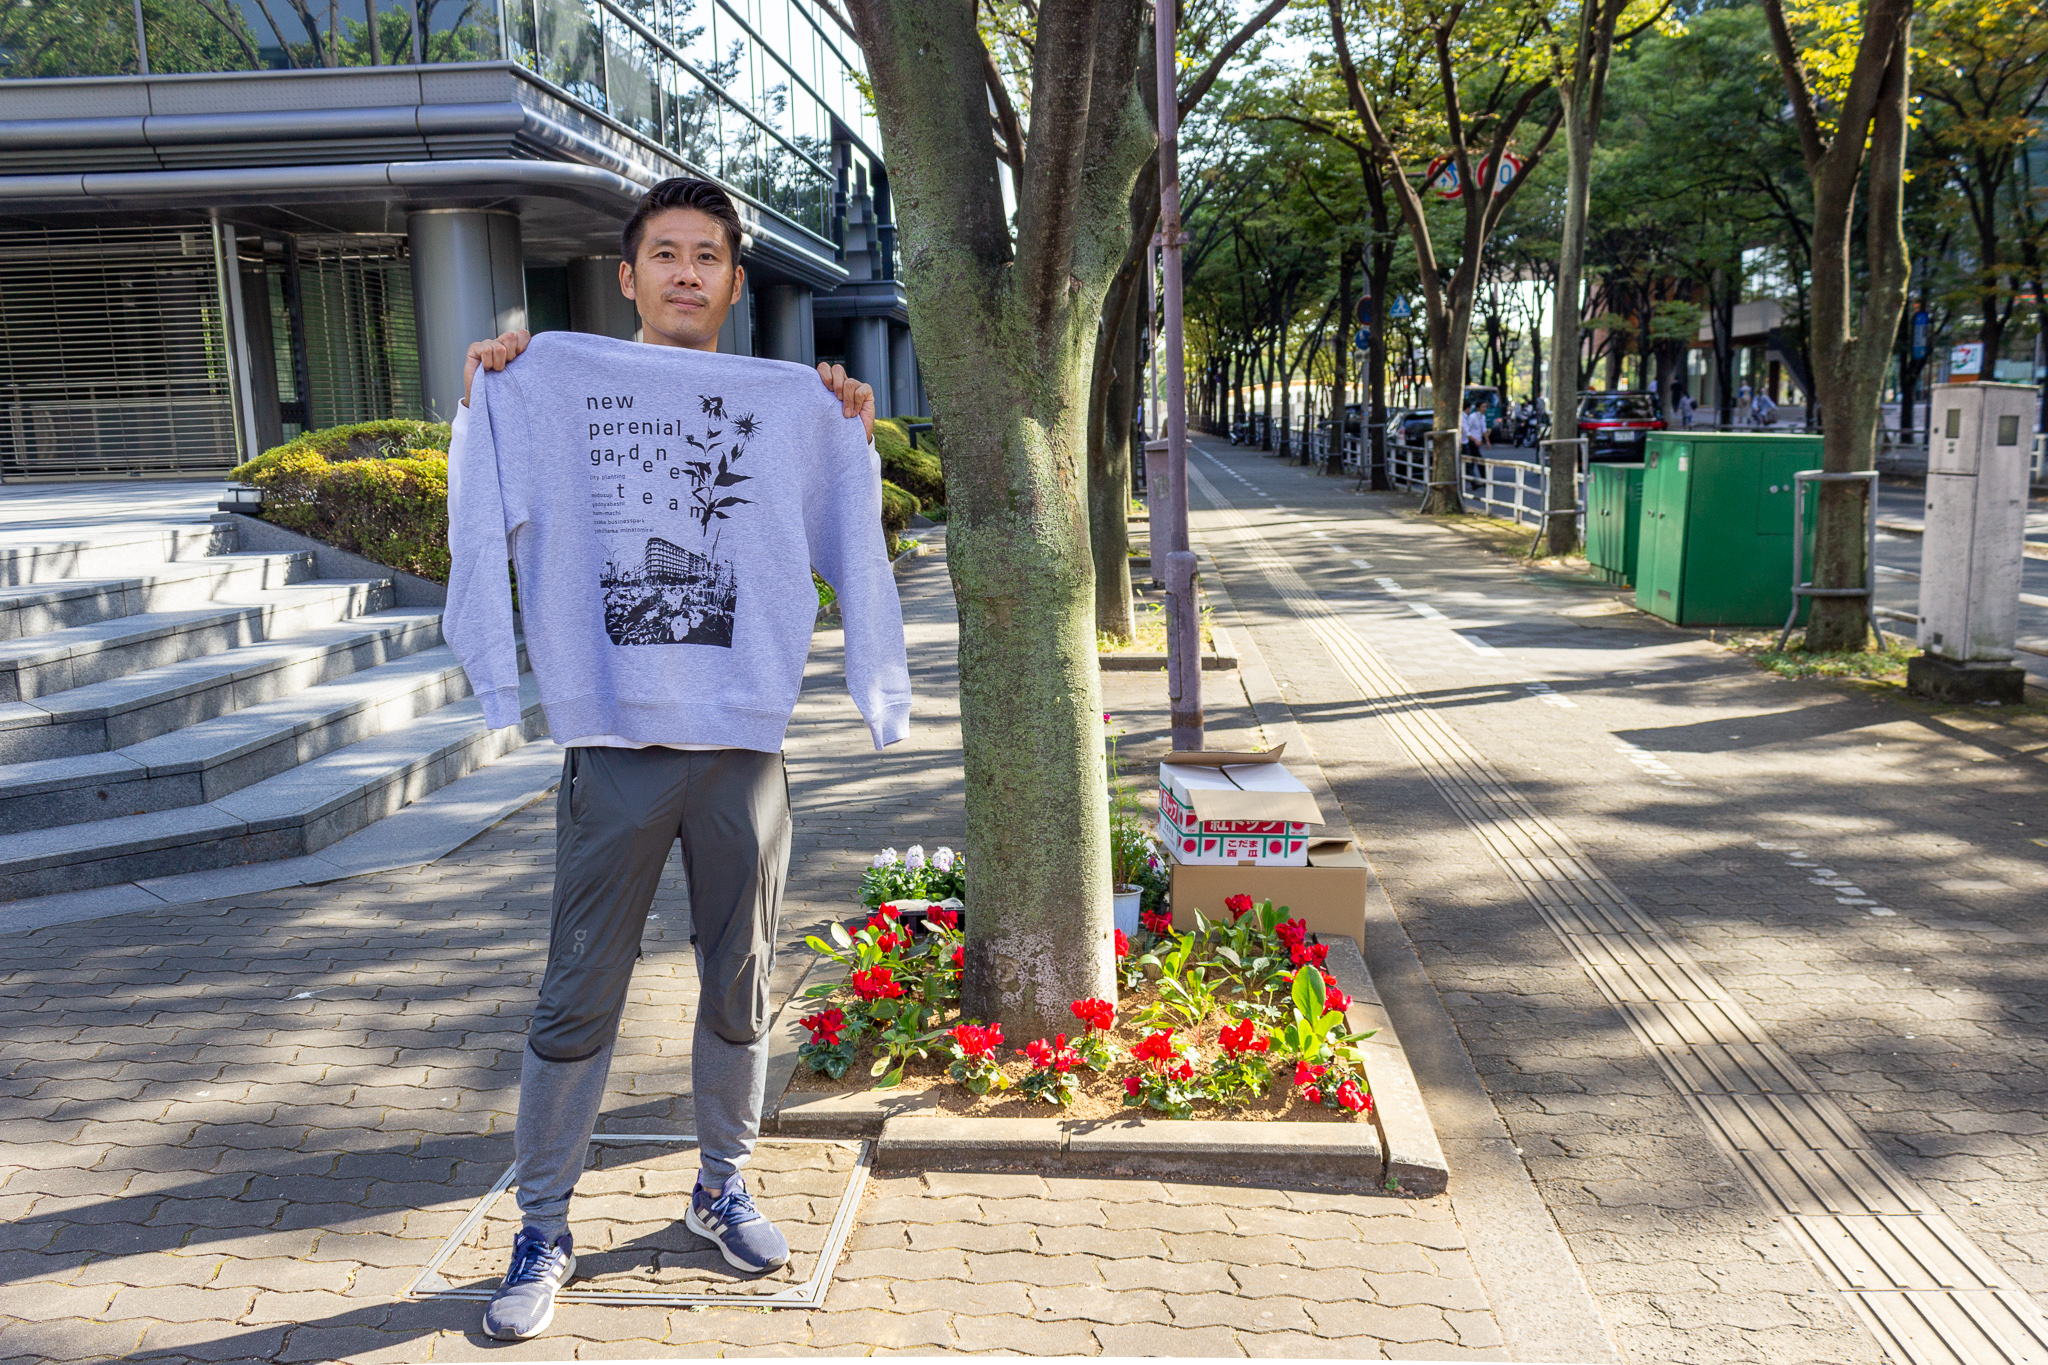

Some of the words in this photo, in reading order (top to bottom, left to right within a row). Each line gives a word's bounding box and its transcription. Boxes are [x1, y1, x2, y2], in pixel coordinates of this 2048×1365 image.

[586, 395, 634, 410] new
[589, 418, 682, 440] perenial
[1228, 839, 1258, 848] こだま
